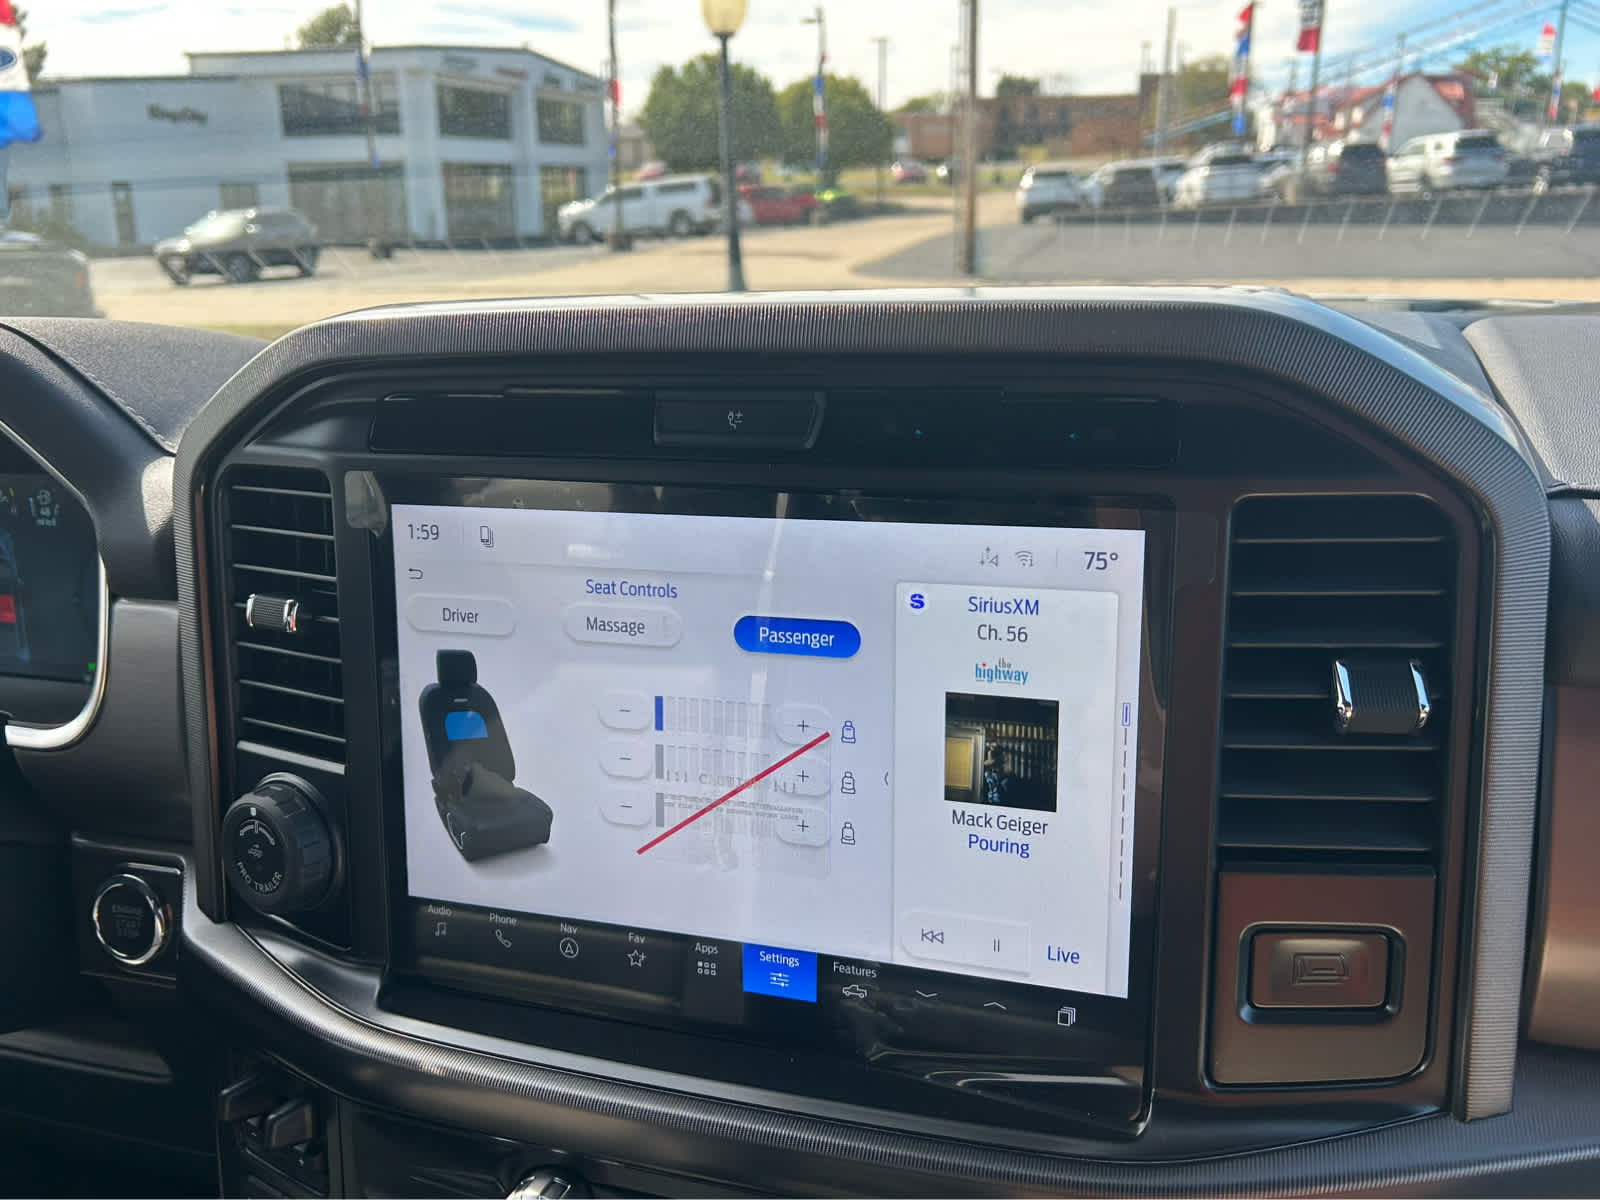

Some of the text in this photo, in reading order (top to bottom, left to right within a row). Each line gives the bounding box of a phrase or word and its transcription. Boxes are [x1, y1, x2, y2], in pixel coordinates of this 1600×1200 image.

[407, 523, 440, 541] 1:59
[585, 578, 678, 599] Seat Controls
[442, 606, 480, 624] Driver
[967, 595, 1040, 617] SiriusXM
[585, 616, 646, 635] Massage
[976, 623, 1029, 643] Ch. 56
[758, 626, 834, 649] Passenger
[975, 662, 1030, 686] highway
[951, 809, 1049, 836] Mack Geiger
[967, 833, 1031, 859] Pouring
[254, 871, 283, 892] TRAILER
[427, 904, 452, 917] Audio
[488, 913, 518, 926] Phone
[560, 922, 579, 935] Nav
[628, 932, 646, 945] Fav
[694, 942, 720, 956] Apps
[1046, 945, 1081, 965] Live
[759, 951, 801, 968] Settings
[832, 961, 877, 979] Features
